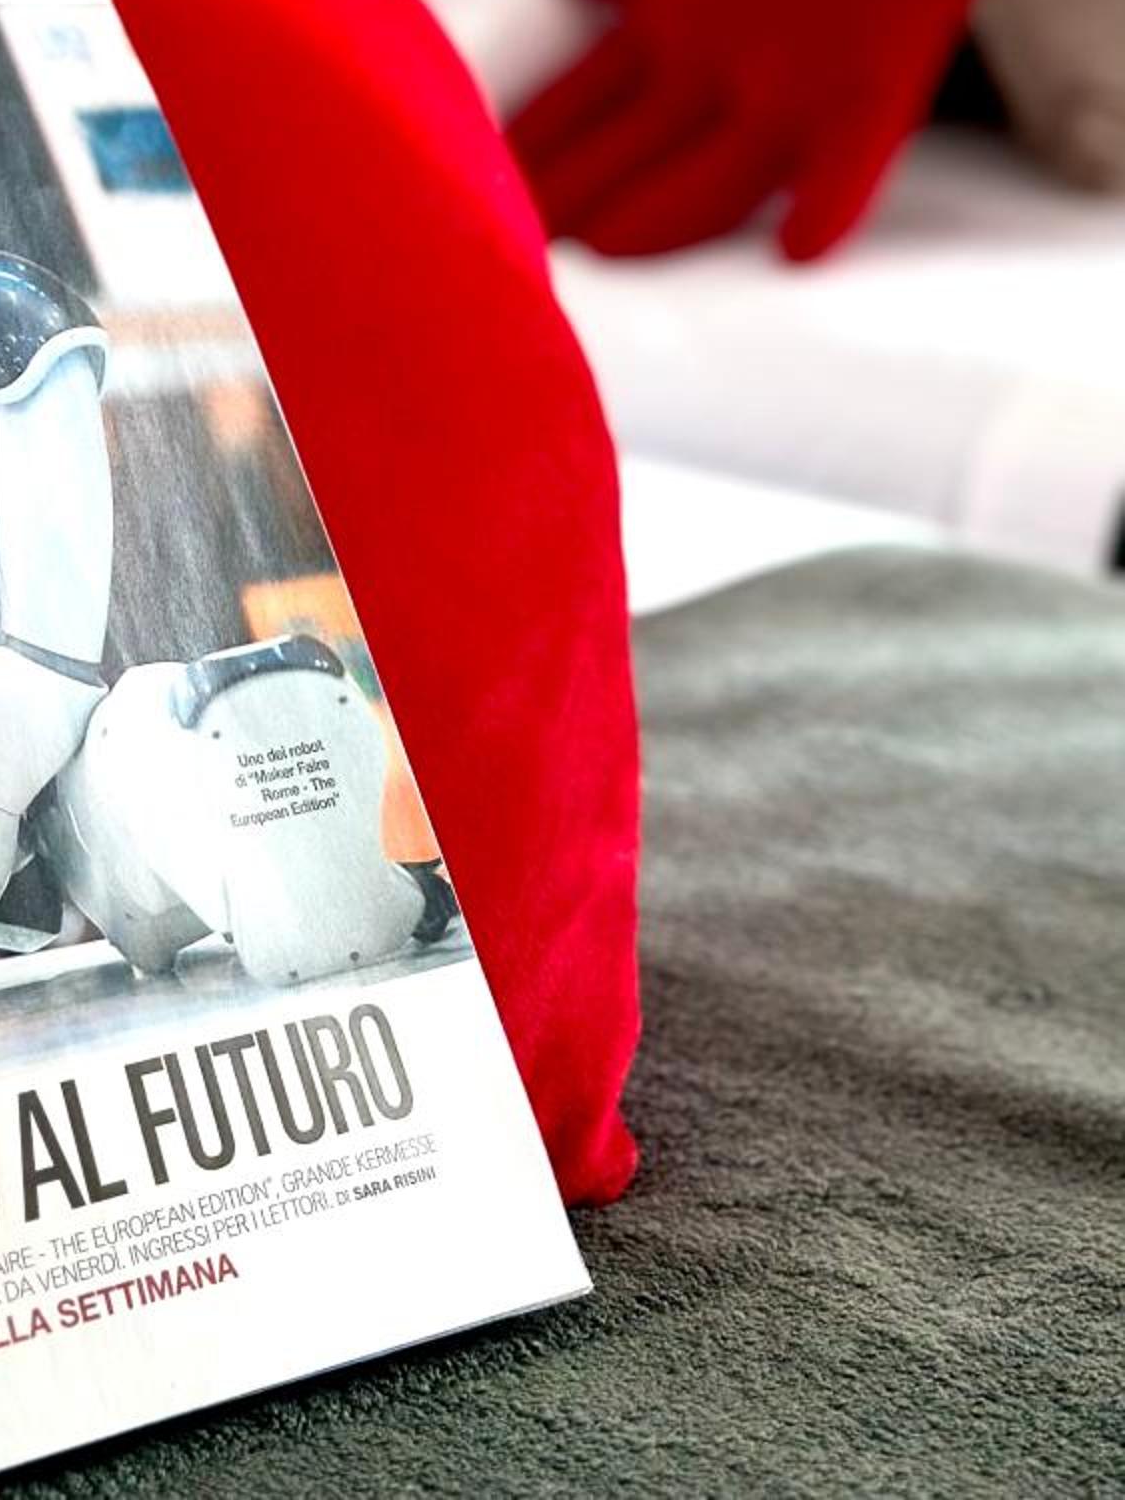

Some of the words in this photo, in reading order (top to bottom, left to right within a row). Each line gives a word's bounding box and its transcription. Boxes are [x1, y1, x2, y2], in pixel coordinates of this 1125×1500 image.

[237, 753, 264, 768] Uno
[267, 745, 287, 762] dei
[289, 740, 326, 757] robot
[297, 758, 330, 775] Faire
[230, 807, 290, 828] European
[290, 791, 340, 816] Edition"
[261, 785, 300, 802] Rome
[309, 777, 336, 791] The
[17, 1078, 130, 1223] AL
[124, 1003, 414, 1186] FUTURO
[50, 1235, 89, 1261] THE
[92, 1205, 197, 1250] EUROPEAN
[282, 1155, 354, 1194] GRANDE
[355, 1133, 437, 1171] KERMESSE
[4, 1275, 36, 1301] DA
[40, 1250, 125, 1296] VENERDÌ.
[129, 1223, 213, 1264] INGRESSI
[213, 1212, 251, 1243] PER
[252, 1211, 260, 1230] I
[261, 1194, 334, 1228] LETTORI.
[336, 1189, 352, 1207] DI
[353, 1175, 393, 1202] SARA
[394, 1165, 437, 1191] RISINI
[57, 1252, 240, 1330] SETTIMANA
